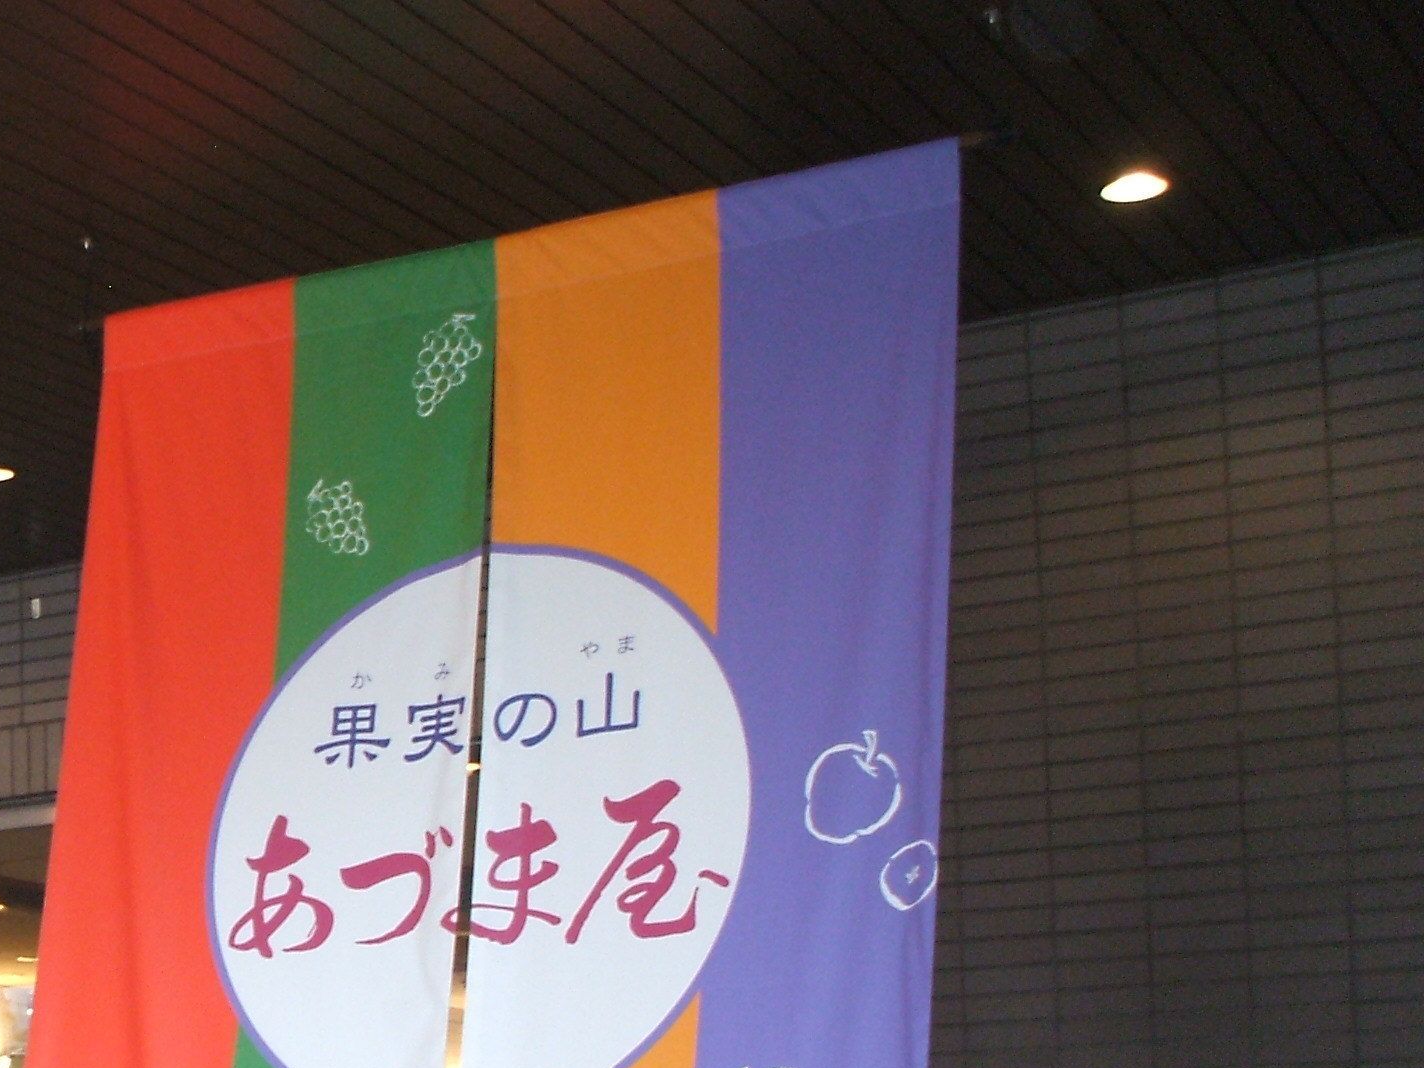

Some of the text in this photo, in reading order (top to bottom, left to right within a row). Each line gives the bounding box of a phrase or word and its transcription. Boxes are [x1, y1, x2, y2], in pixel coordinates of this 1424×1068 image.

[314, 672, 642, 769] 果実の山
[228, 779, 730, 958] あづま屋
